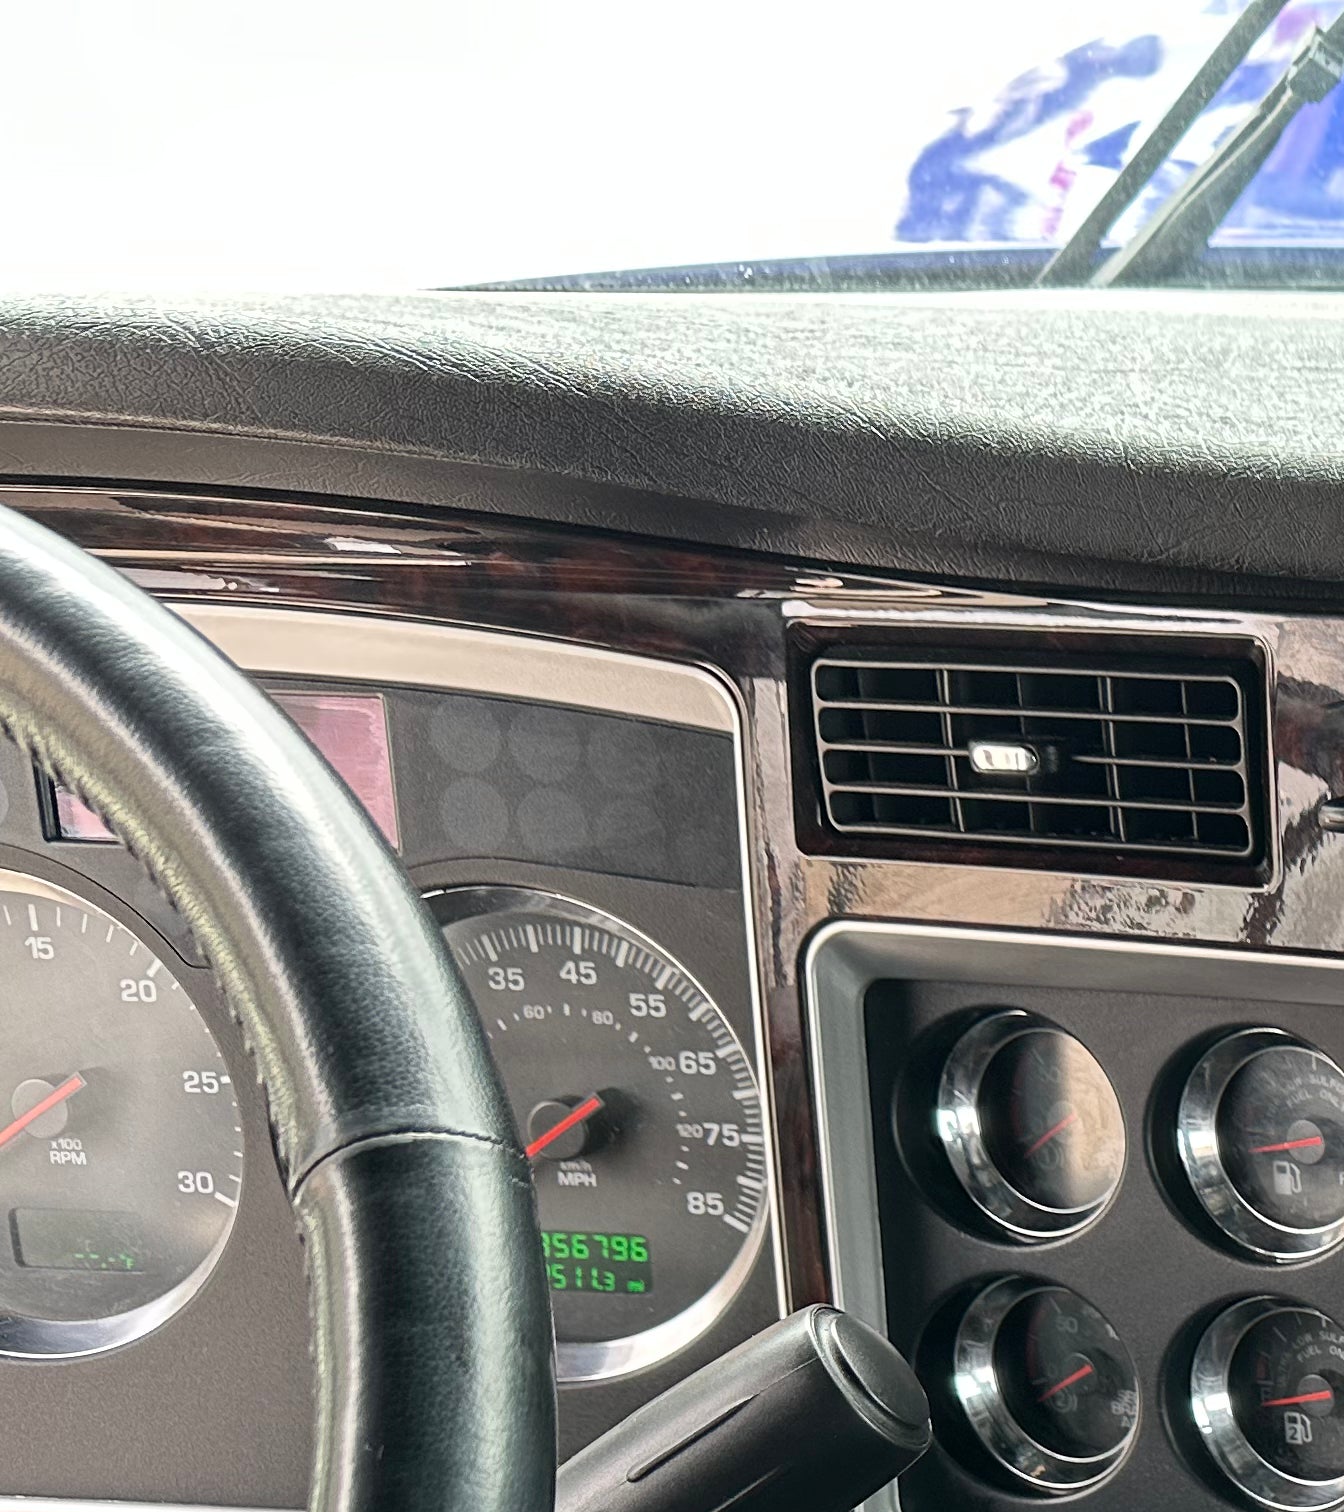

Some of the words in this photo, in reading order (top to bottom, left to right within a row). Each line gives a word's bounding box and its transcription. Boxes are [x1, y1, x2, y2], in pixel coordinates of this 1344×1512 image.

[25, 936, 54, 959] 15
[487, 967, 525, 991] 35
[559, 961, 597, 985] 45
[119, 978, 157, 1002] 20
[523, 1005, 545, 1020] 60
[628, 992, 667, 1018] 55
[592, 1010, 614, 1025] 80
[649, 1056, 676, 1071] 100
[679, 1051, 717, 1075] 65
[183, 1071, 219, 1094] 25
[702, 1122, 741, 1147] 75
[49, 1150, 87, 1166] RPM
[177, 1170, 214, 1195] 30
[557, 1172, 597, 1188] MPH
[686, 1191, 724, 1215] 85
[1297, 1344, 1323, 1363] FUEL
